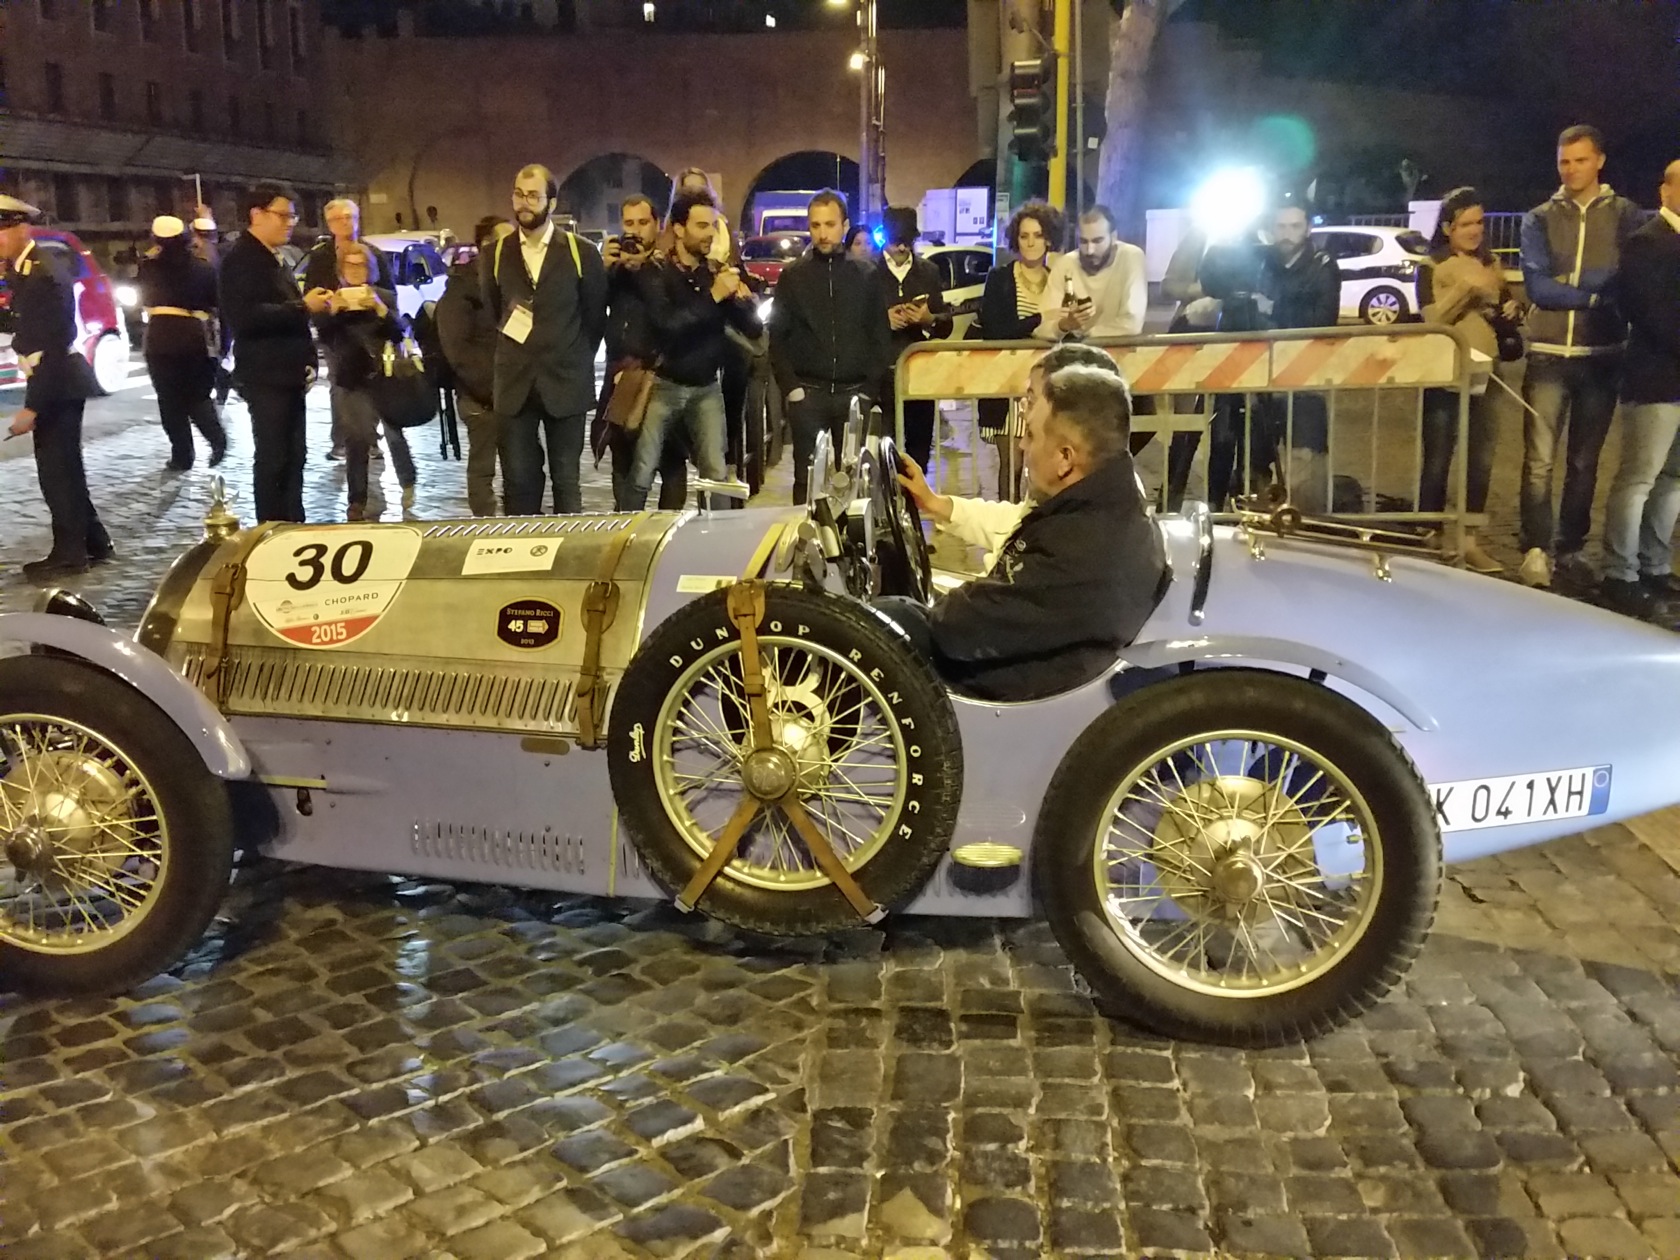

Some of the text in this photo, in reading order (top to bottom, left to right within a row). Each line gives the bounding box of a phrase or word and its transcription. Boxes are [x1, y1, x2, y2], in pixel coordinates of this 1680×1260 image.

[285, 539, 374, 591] 30
[324, 592, 379, 606] CHOPARD
[310, 622, 347, 644] 2015
[507, 619, 524, 633] 45
[668, 621, 811, 669] DUNOP
[1471, 773, 1586, 823] 041XH
